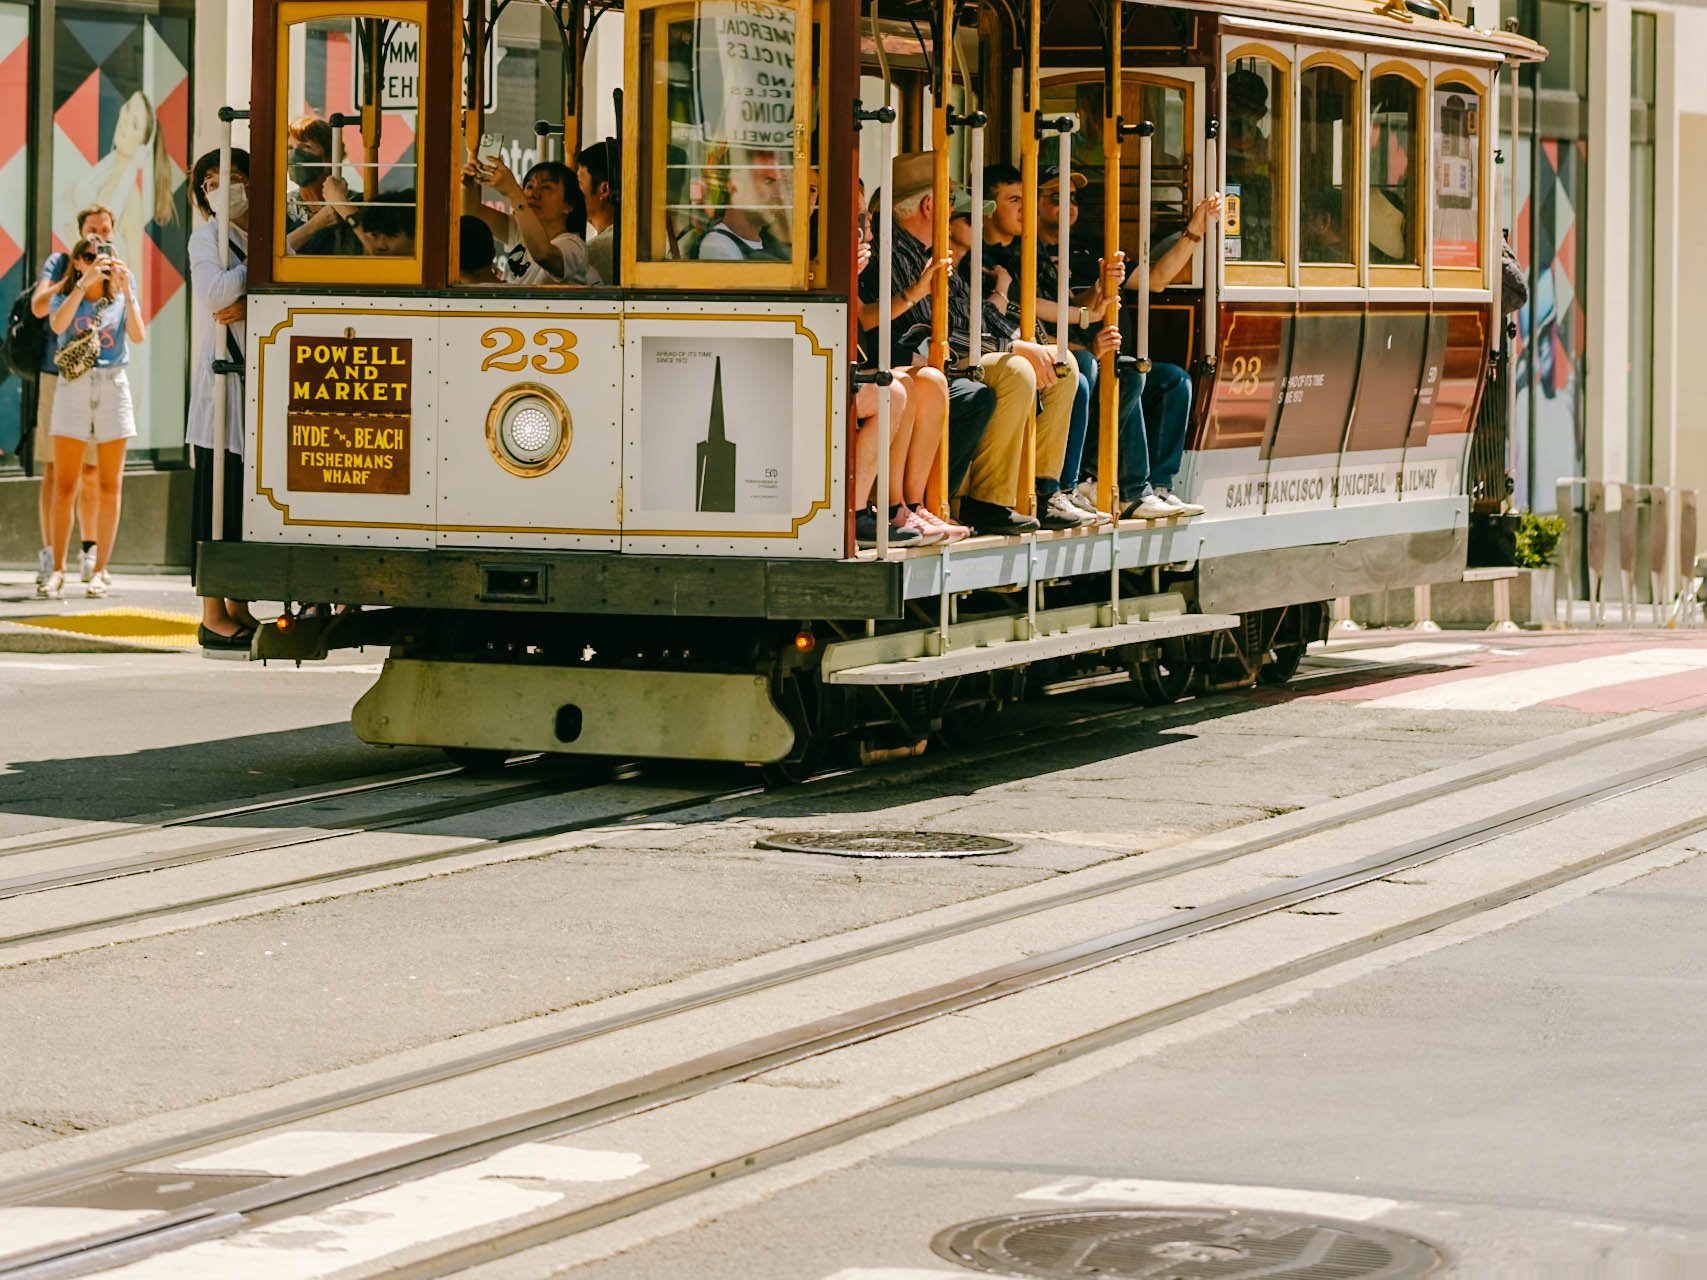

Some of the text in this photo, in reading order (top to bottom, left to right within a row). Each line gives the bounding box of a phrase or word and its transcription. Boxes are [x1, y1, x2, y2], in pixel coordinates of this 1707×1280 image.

[296, 345, 406, 365] POWELL
[480, 326, 580, 375] 23
[324, 365, 379, 380] AND
[1227, 356, 1262, 395] 23
[293, 381, 408, 401] MARKET
[292, 425, 404, 450] HYDE AND BEACH
[301, 451, 394, 470] FISHERMANS
[322, 469, 371, 485] WHARF
[1225, 483, 1252, 508] SAN
